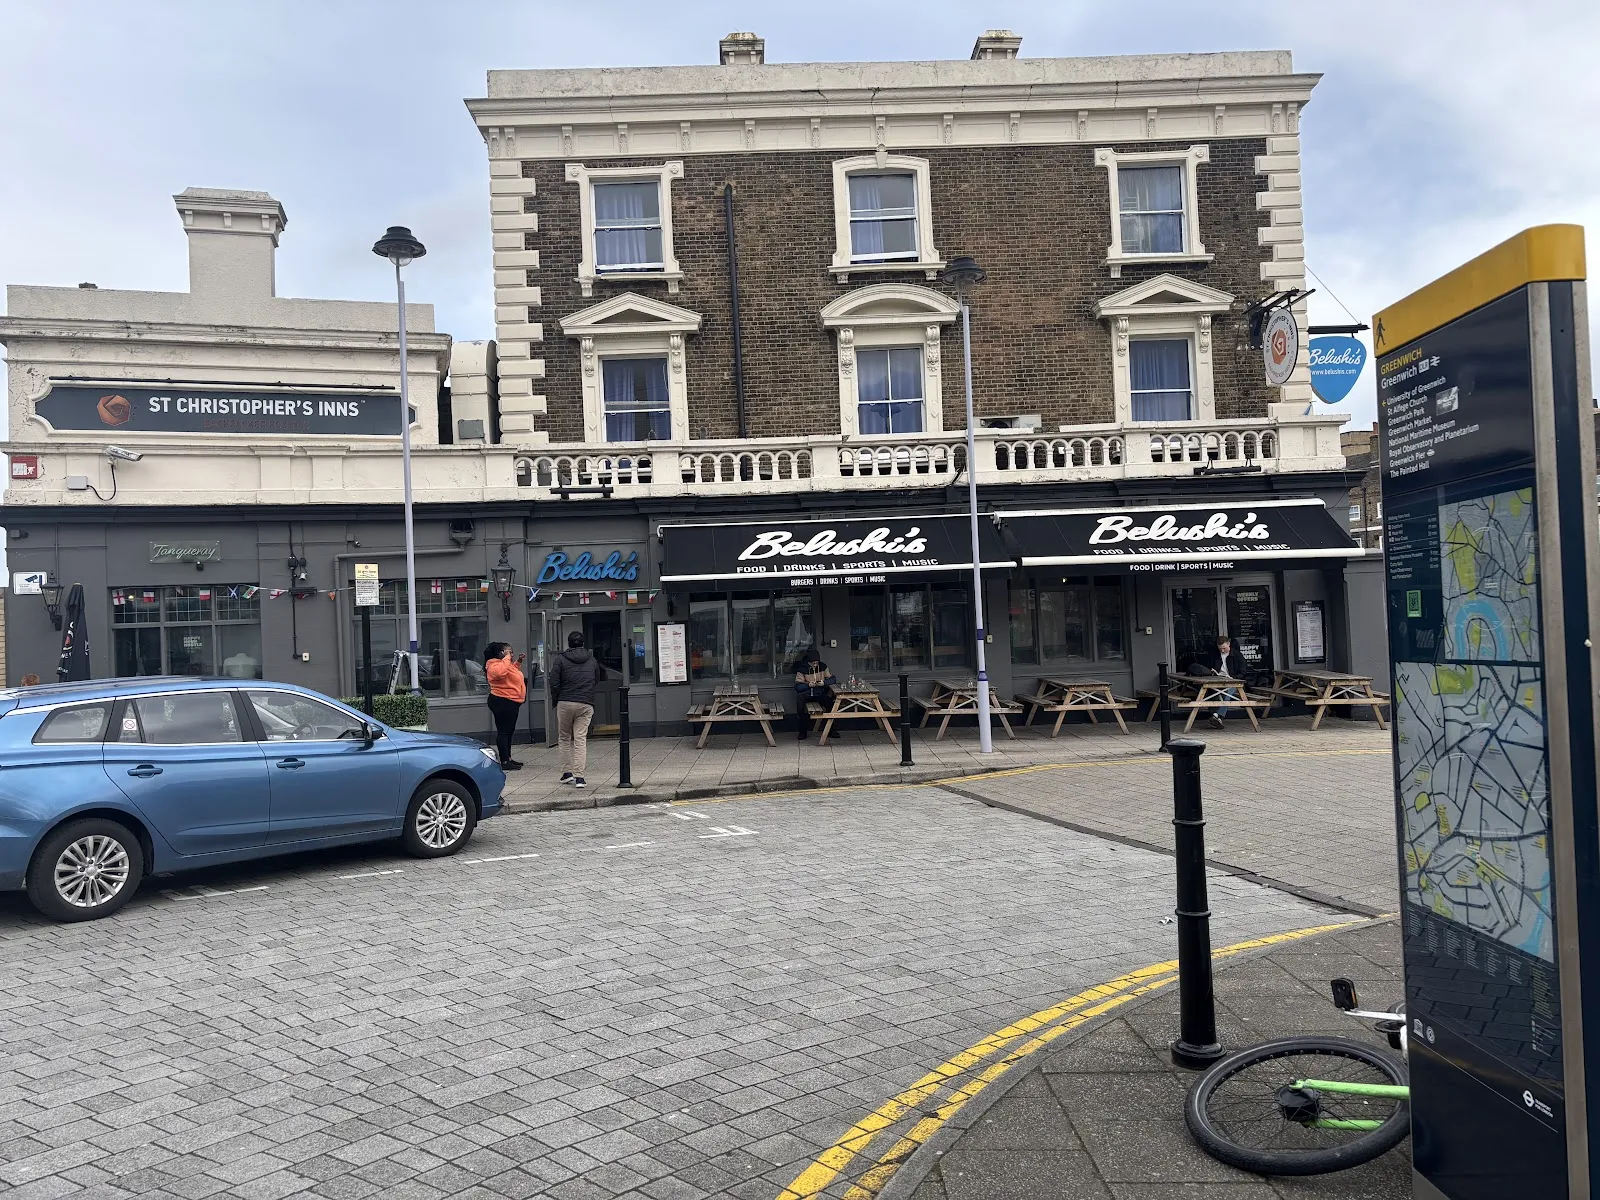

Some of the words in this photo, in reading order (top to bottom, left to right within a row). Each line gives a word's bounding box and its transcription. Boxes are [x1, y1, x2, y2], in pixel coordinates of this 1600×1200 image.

[1309, 348, 1361, 366] Belushi's
[1380, 348, 1422, 375] GREENWICH
[1381, 365, 1417, 389] Greenwich
[1386, 390, 1411, 406] University
[1411, 386, 1418, 396] of
[1418, 375, 1447, 393] Greenwich
[149, 397, 171, 413] ST
[176, 397, 314, 416] CHRISTOPHER'S
[319, 401, 359, 417] INNS
[1393, 402, 1409, 414] Alfege
[1409, 395, 1428, 408] Church
[1387, 411, 1414, 427] Greenwich
[1413, 407, 1425, 417] Park
[1388, 422, 1414, 437] Greenwich
[1414, 416, 1432, 428] Market
[1388, 434, 1409, 447] National
[1409, 428, 1432, 441] Maritime
[1432, 420, 1456, 433] Museum
[1388, 447, 1402, 458] Royal
[1402, 438, 1433, 454] Observatory
[1433, 434, 1444, 444] and
[1444, 423, 1480, 440] Planetarium
[1389, 454, 1414, 468] Greenwich
[1415, 451, 1426, 460] Pier
[1390, 469, 1400, 478] The
[1400, 463, 1418, 476] Painted
[1418, 460, 1430, 471] Hall
[1088, 512, 1270, 545] Belushi's
[153, 544, 216, 559] Tanqueray
[738, 527, 927, 561] Belushi's
[1253, 543, 1291, 551] MUSIC
[536, 551, 639, 584] Belushi's
[783, 563, 826, 571] DRINKS
[842, 560, 886, 569] SPORTS
[902, 558, 939, 567] MUSIC
[1180, 562, 1208, 570] SPORTS
[1212, 561, 1234, 569] MUSIC
[790, 577, 814, 586] BURGERS
[820, 576, 839, 585] DRINKS
[844, 576, 864, 584] SPORTS
[869, 575, 886, 583] MUSIC
